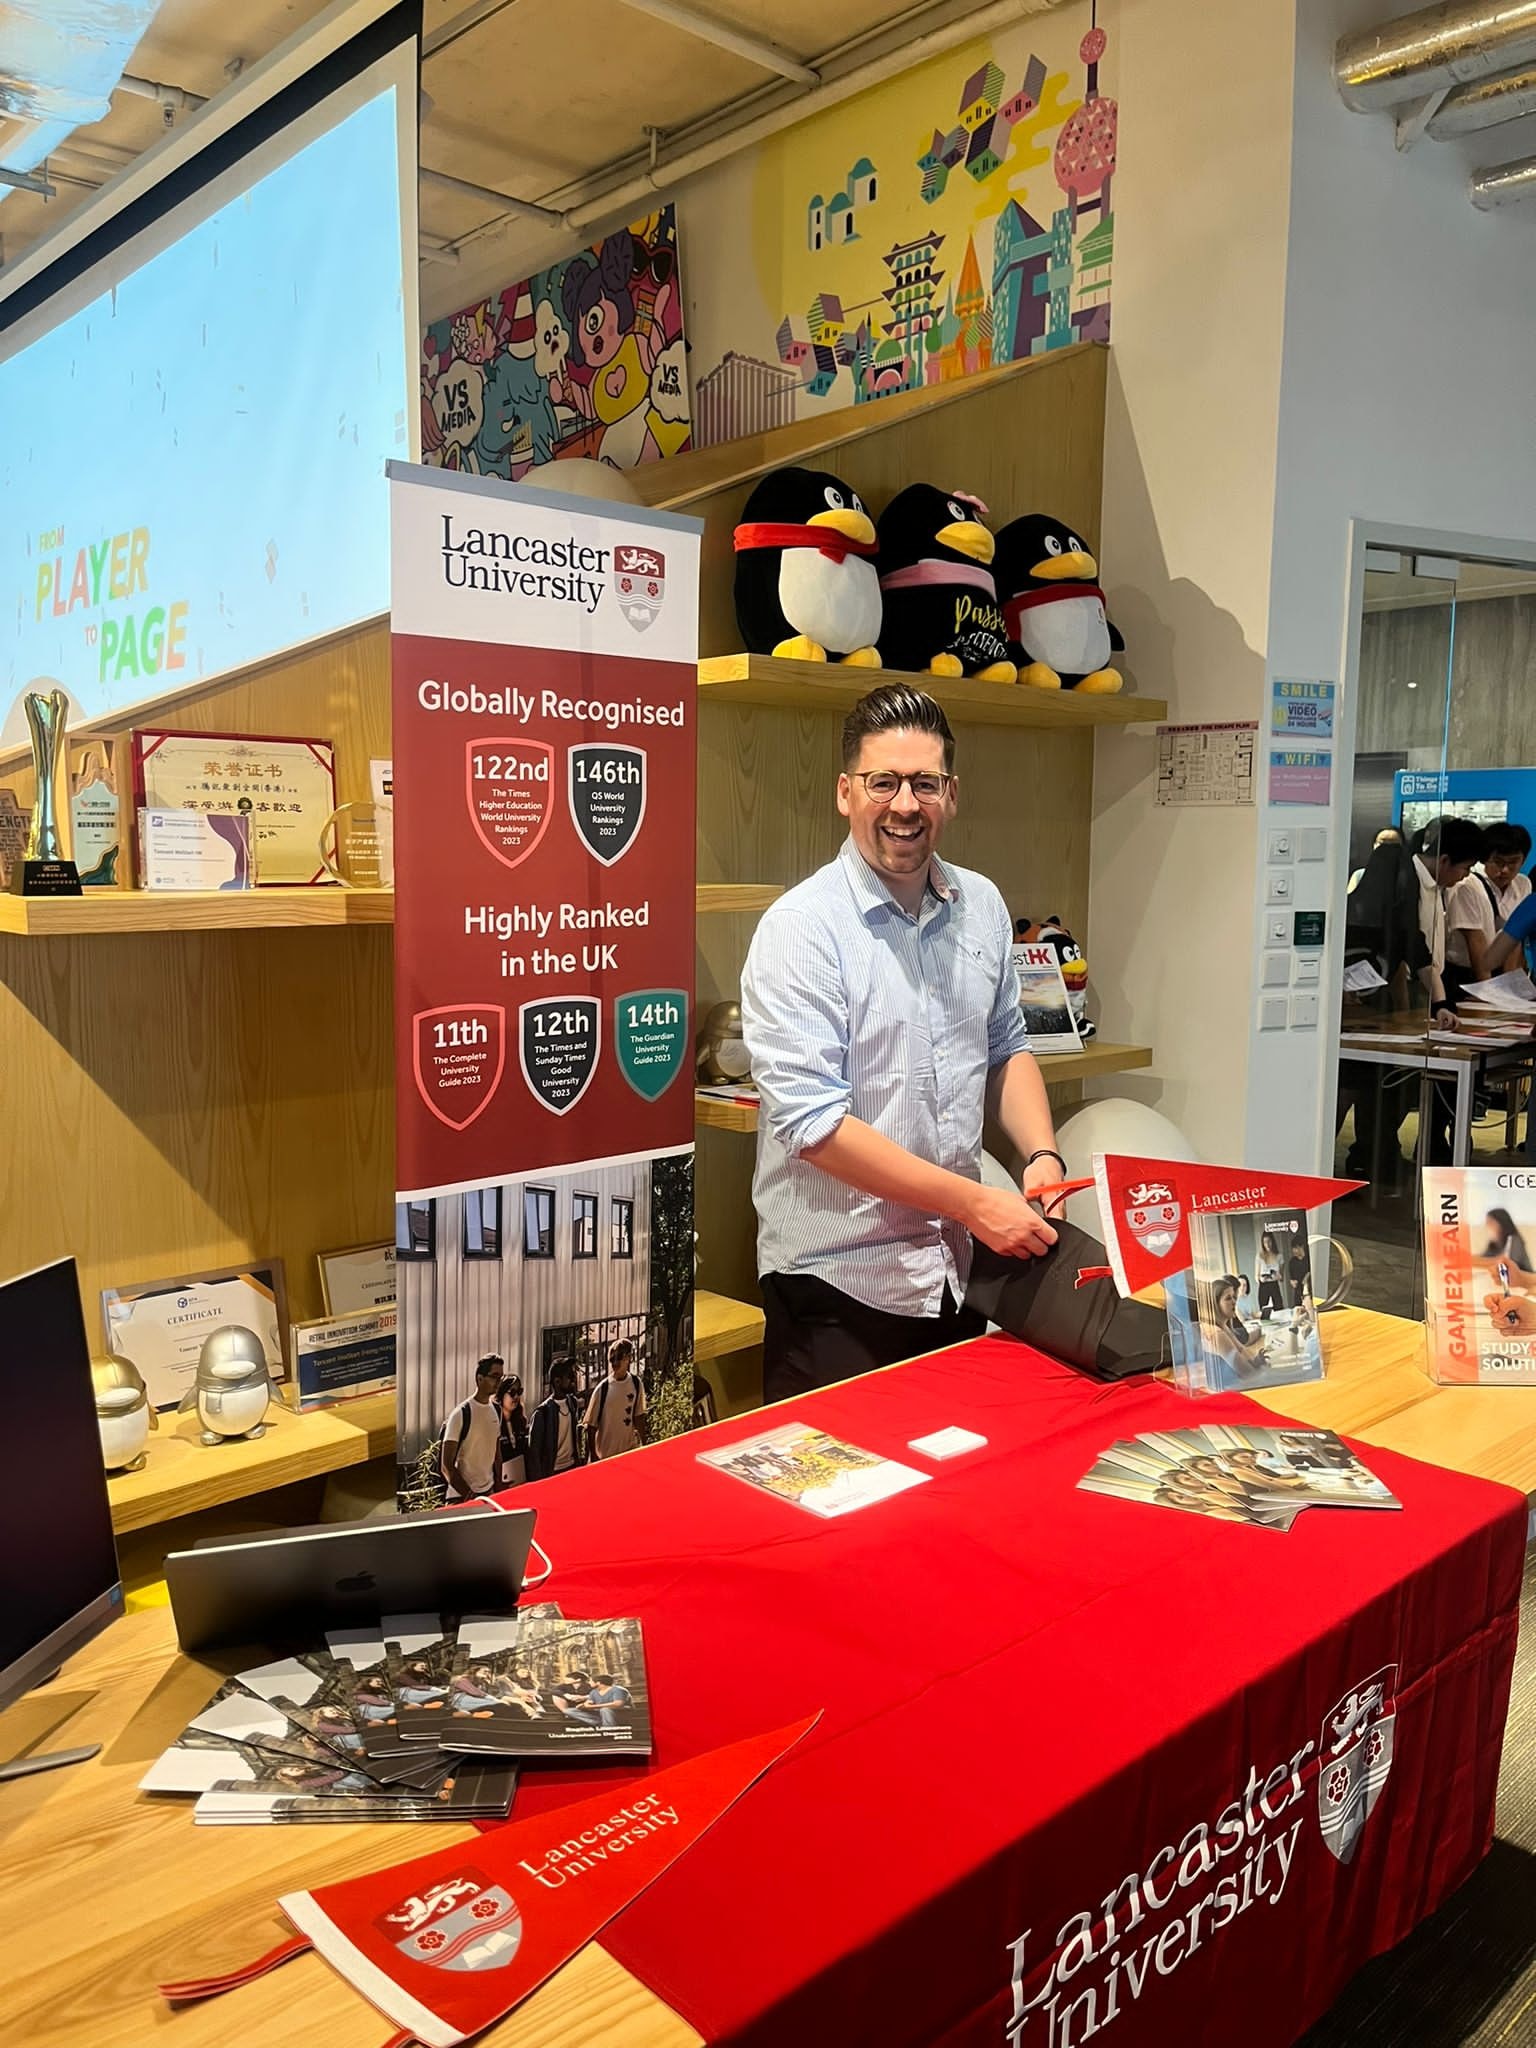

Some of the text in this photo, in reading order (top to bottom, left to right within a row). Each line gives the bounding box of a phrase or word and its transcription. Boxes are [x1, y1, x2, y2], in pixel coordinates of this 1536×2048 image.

[663, 364, 679, 384] VS
[443, 379, 469, 411] VS
[658, 382, 681, 396] MEDIA
[441, 408, 476, 432] MEDIA
[39, 525, 64, 553] FROM
[441, 514, 610, 574] Lancaster
[36, 526, 150, 622] PLAYER
[441, 551, 605, 613] University
[85, 624, 97, 646] TO
[100, 601, 189, 683] PAGE
[1281, 683, 1327, 697] SMILE
[418, 680, 684, 729] Globally Recognised
[1288, 705, 1317, 716] VIDEO
[1285, 753, 1318, 766] WIFI
[203, 762, 283, 778] 荣誉证书
[473, 755, 549, 781] 122nd
[576, 760, 640, 784] 146th
[492, 789, 531, 798] The Times
[591, 792, 625, 801] QS World
[479, 800, 542, 811] Higher Education
[590, 804, 626, 814] University
[481, 813, 541, 824] World University
[592, 816, 624, 825] Rankings
[495, 825, 528, 834] Rankings
[599, 828, 617, 836] 2023
[502, 837, 521, 845] 2023
[464, 901, 649, 941] Highly Ranked
[501, 944, 619, 977] in the UK
[627, 1001, 679, 1028] 14th
[532, 1009, 589, 1037] 12th
[433, 1019, 488, 1048] 11th
[630, 1032, 675, 1043] The Guardian
[534, 1042, 587, 1053] The Times and
[635, 1044, 669, 1054] University
[433, 1052, 487, 1065] The Complete
[535, 1053, 586, 1066] Sunday Times
[633, 1054, 671, 1066] Guide 2023
[440, 1064, 480, 1076] University
[551, 1066, 572, 1075] Good
[438, 1075, 481, 1088] Guide 2023
[542, 1076, 579, 1088] University
[551, 1089, 570, 1098] 2023
[1191, 1186, 1267, 1209] Lancaster
[1440, 1194, 1465, 1358] GAME2LEARN
[167, 1307, 224, 1326] CERTIFICATE
[380, 1314, 396, 1329] 2019
[517, 1792, 664, 1877] Lancaster
[535, 1805, 683, 1889] University
[1006, 1740, 1315, 2028] Lancaster
